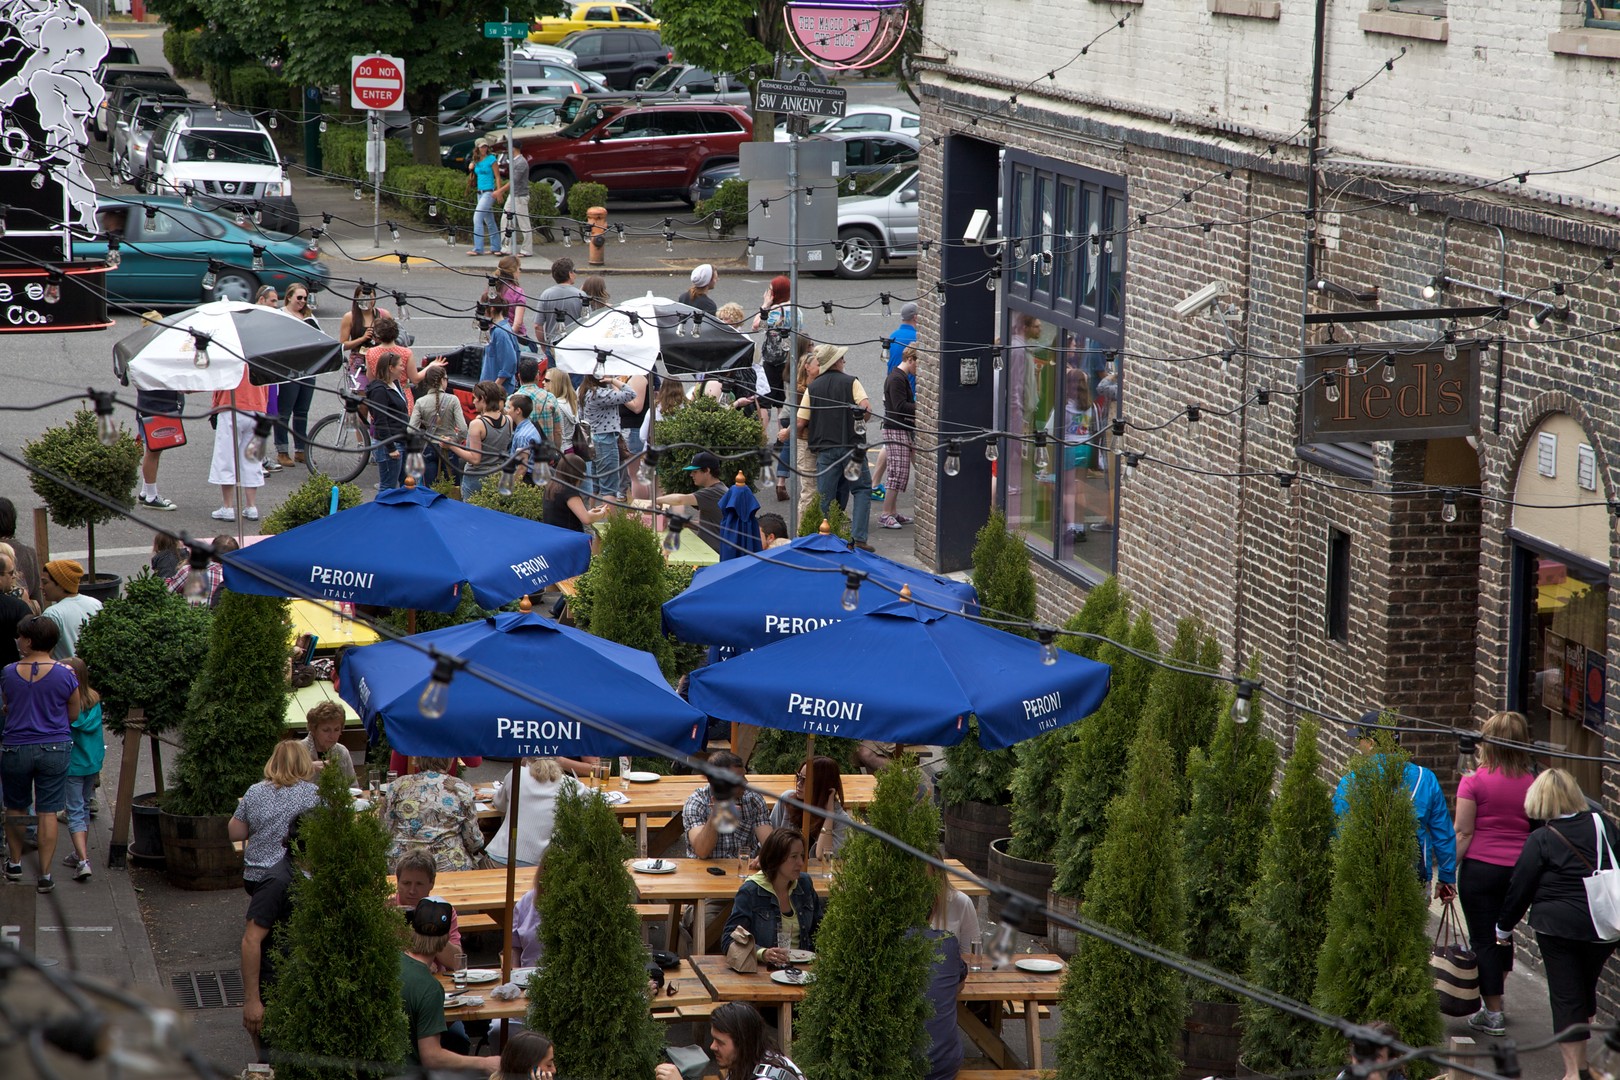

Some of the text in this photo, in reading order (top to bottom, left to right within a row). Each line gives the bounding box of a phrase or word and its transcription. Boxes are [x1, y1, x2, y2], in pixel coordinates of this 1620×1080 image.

[799, 16, 872, 32] THE MAGIC IS IN
[814, 32, 856, 48] THE HOLE
[359, 66, 396, 77] DO NOT
[362, 90, 393, 100] ENTER
[760, 93, 844, 115] SW ANKENY ST
[1321, 362, 1463, 421] Ted's
[510, 554, 550, 580] PERONI
[310, 565, 374, 589] PERONI
[323, 588, 354, 599] ITALY
[787, 693, 863, 721] PERONI
[1022, 691, 1062, 720] PERONI
[496, 717, 582, 740] PERONI
[803, 720, 839, 733] ITALY
[1038, 717, 1057, 731] ITALY
[518, 744, 559, 755] ITALY
